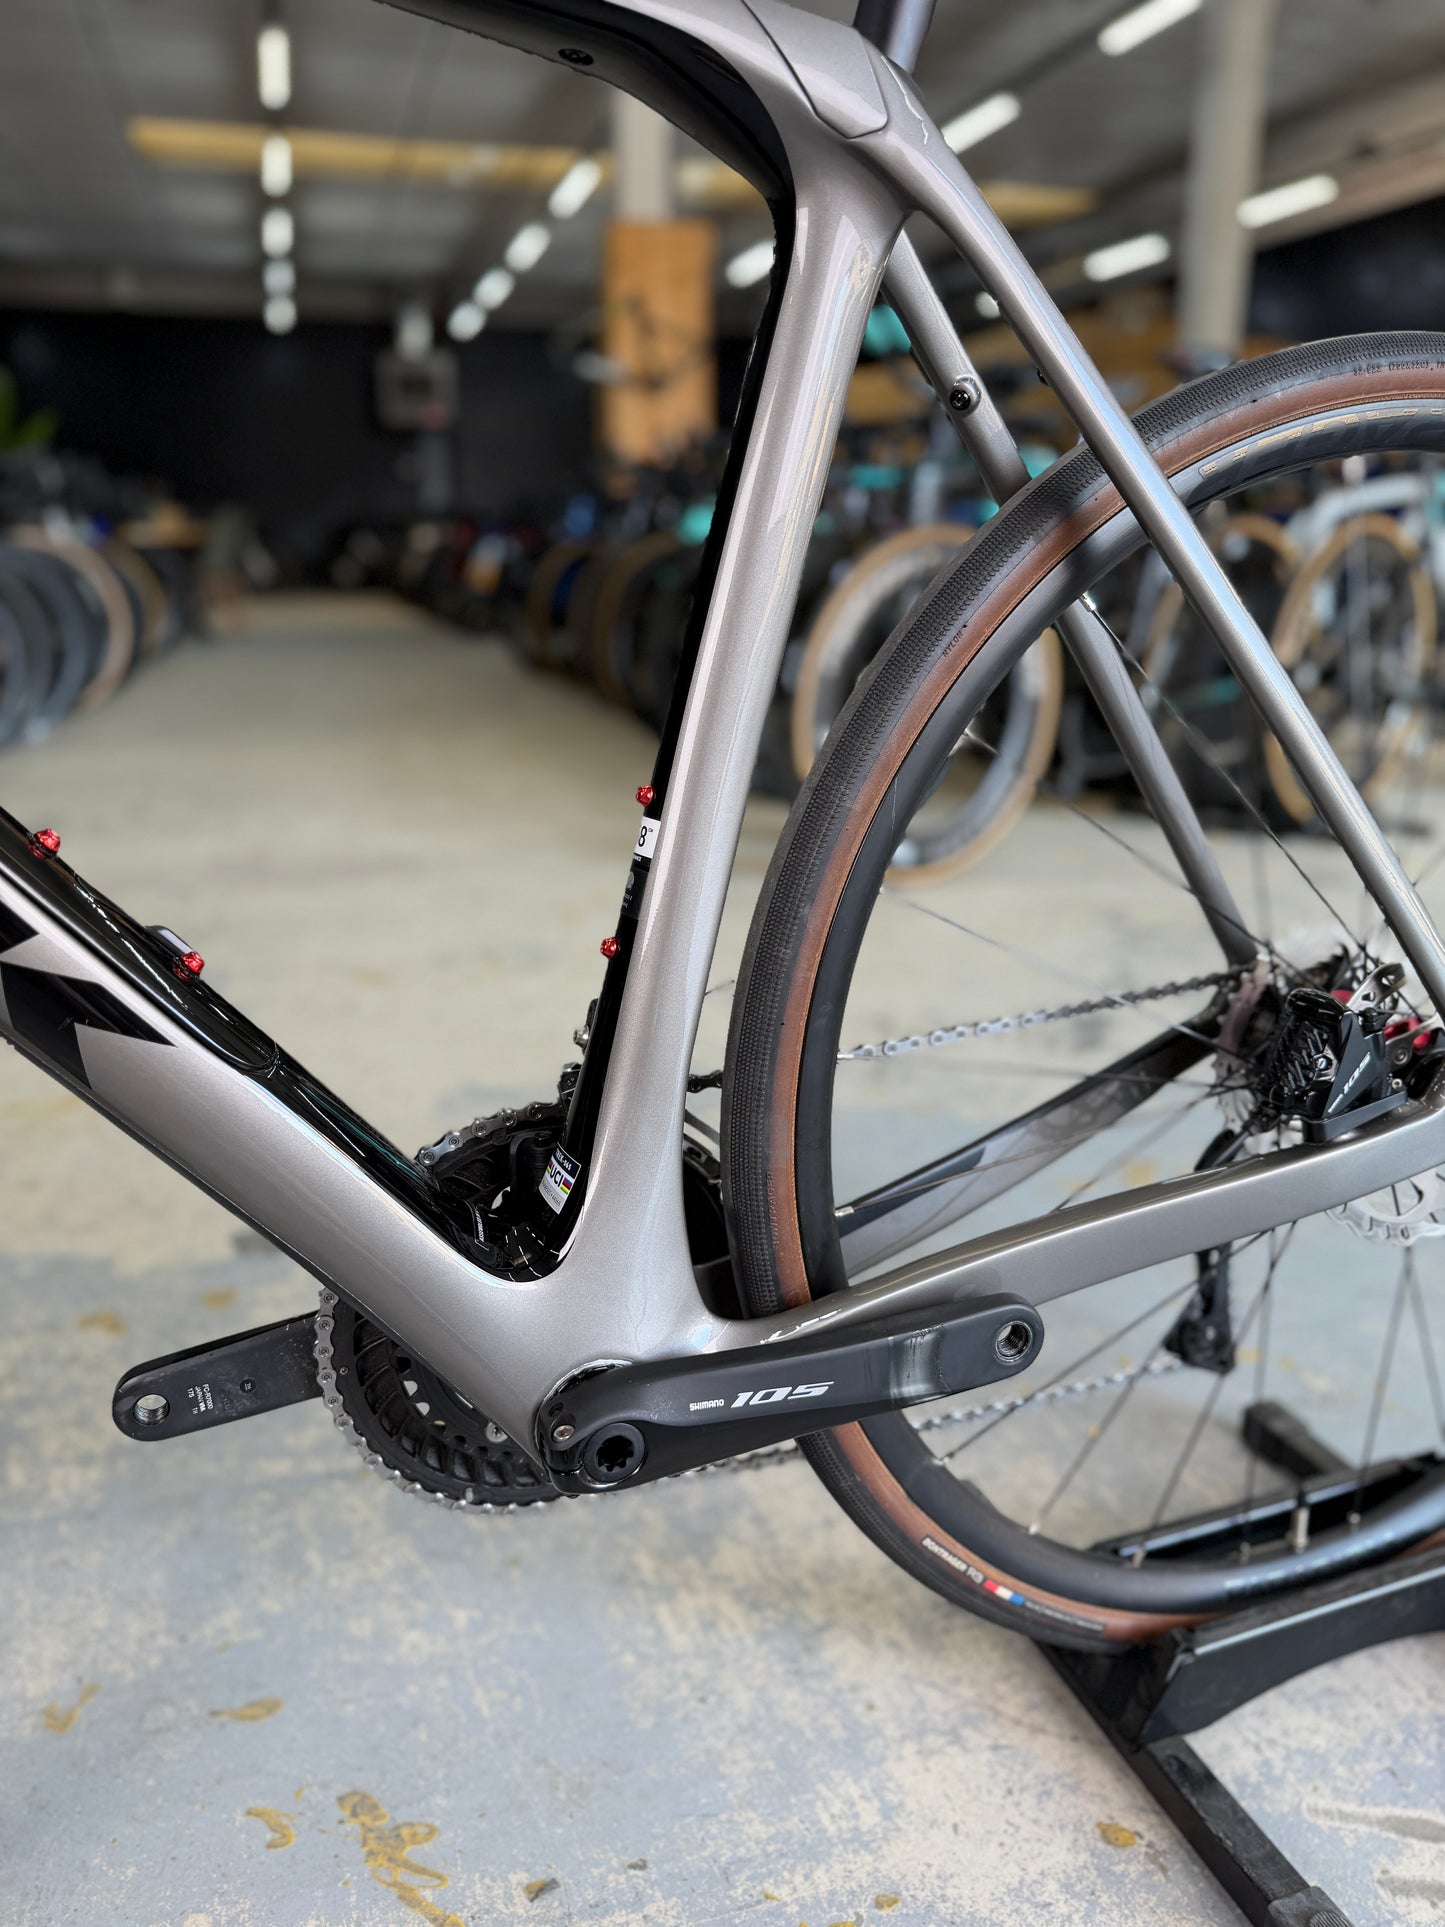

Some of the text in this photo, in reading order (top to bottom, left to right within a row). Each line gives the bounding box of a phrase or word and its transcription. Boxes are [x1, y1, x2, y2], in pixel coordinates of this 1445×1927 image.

[942, 630, 963, 658] NYLON
[549, 1163, 565, 1188] UCI
[689, 1381, 834, 1412] SHIMANO 105
